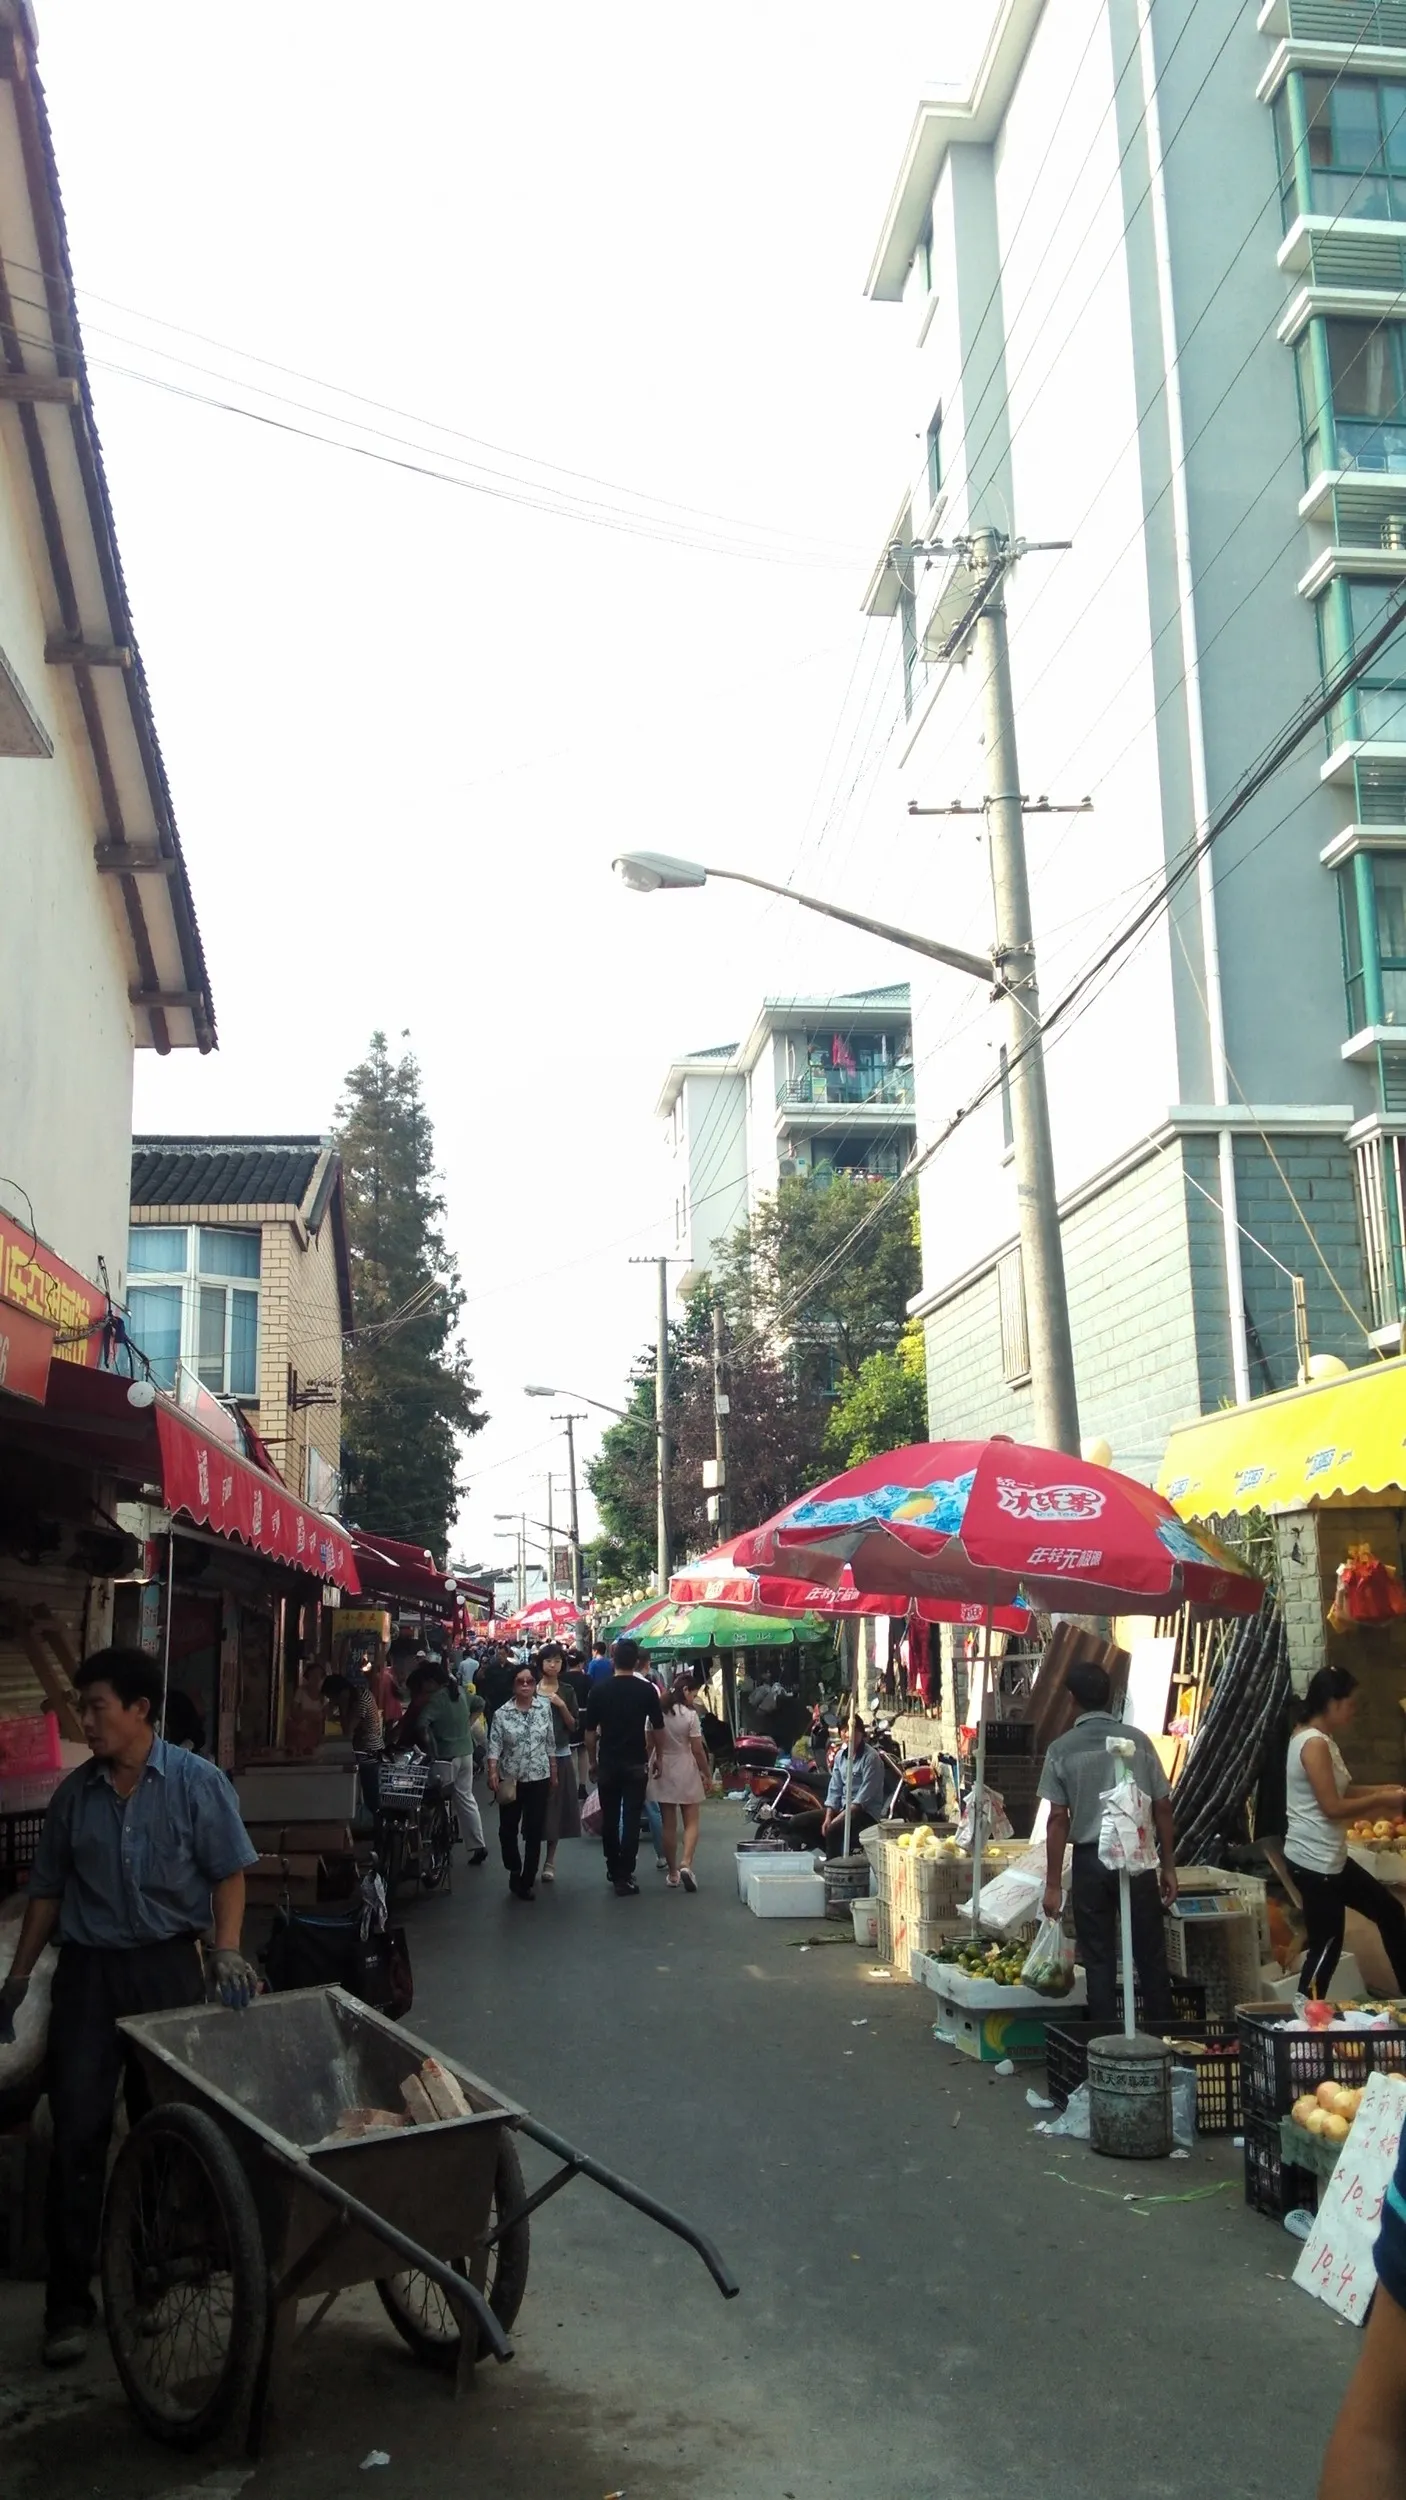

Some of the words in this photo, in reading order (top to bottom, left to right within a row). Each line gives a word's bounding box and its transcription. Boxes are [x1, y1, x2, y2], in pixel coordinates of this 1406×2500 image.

[1001, 1488, 1101, 1516] 冰红茶
[1027, 1546, 1103, 1570] 年轻无极限
